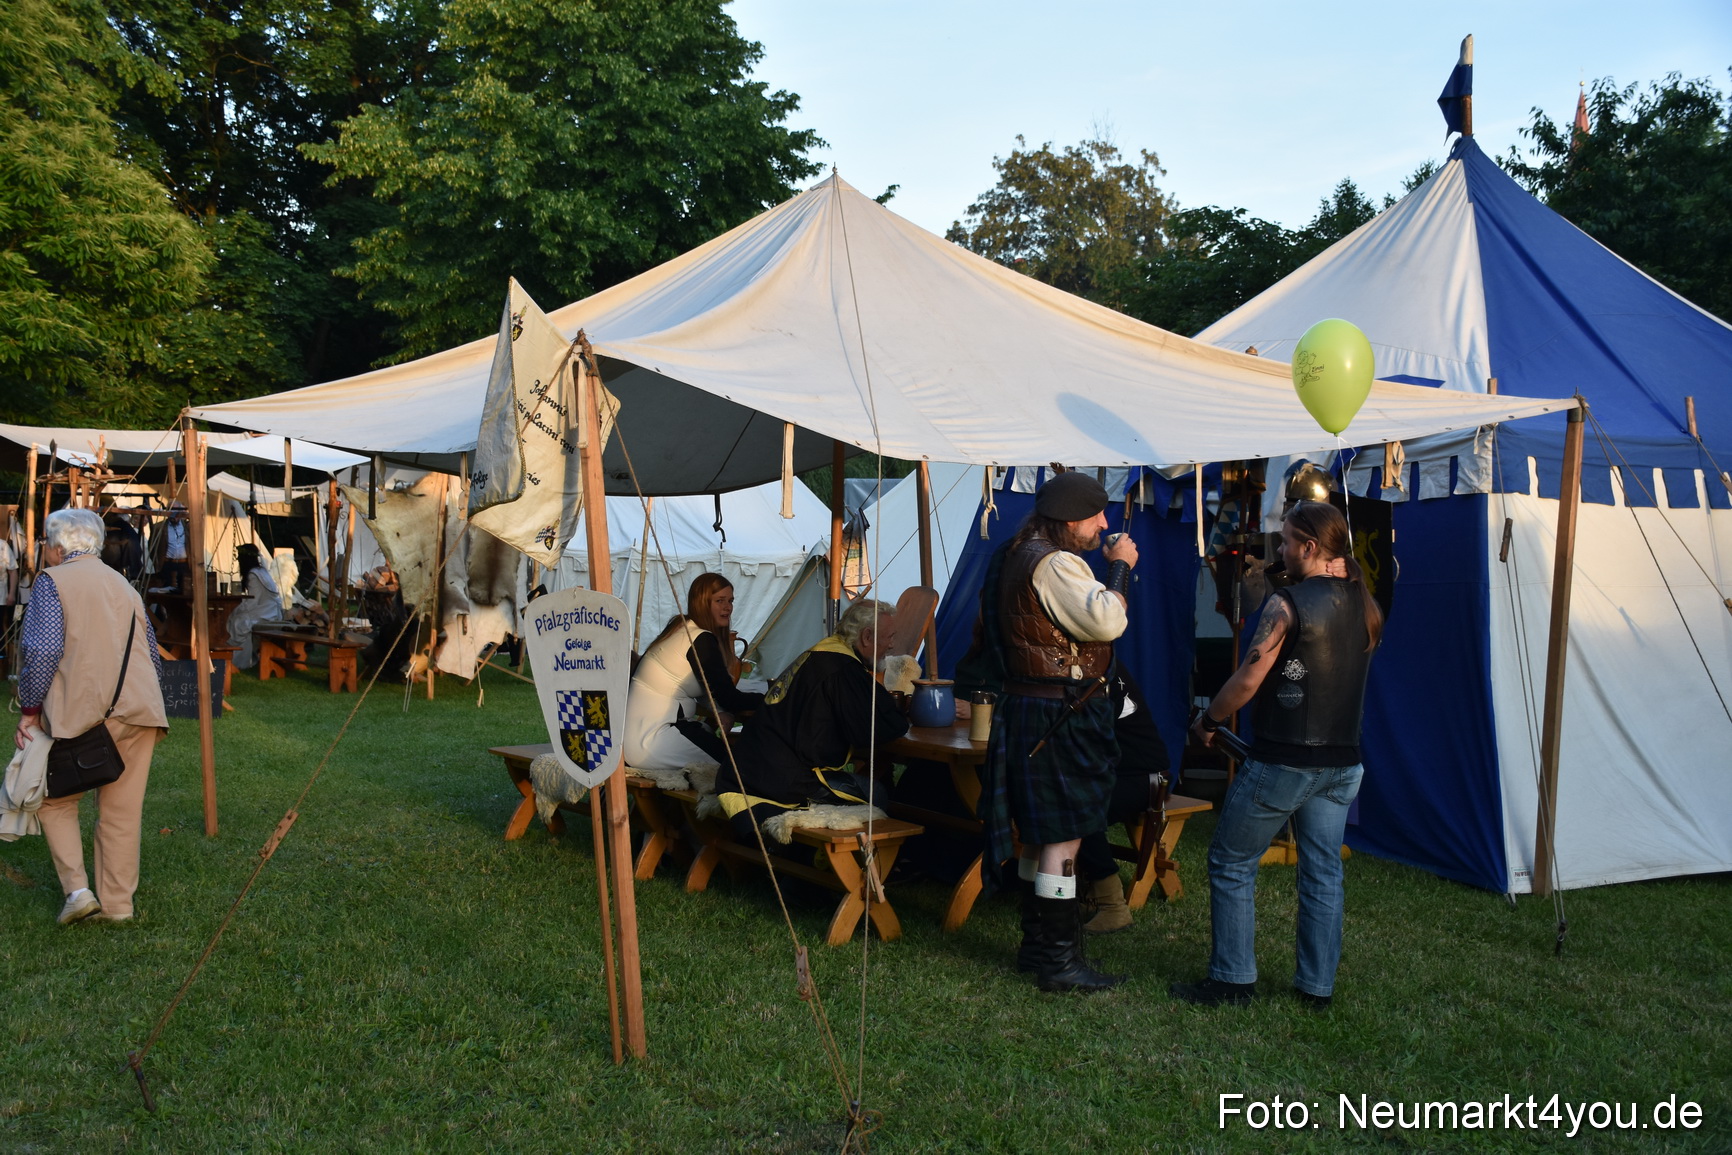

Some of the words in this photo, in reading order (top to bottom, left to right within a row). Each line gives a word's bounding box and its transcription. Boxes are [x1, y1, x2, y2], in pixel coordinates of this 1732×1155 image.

[535, 606, 621, 636] Pfalzgräfisches
[565, 638, 592, 651] Gefolge
[554, 652, 606, 671] Neumarkt
